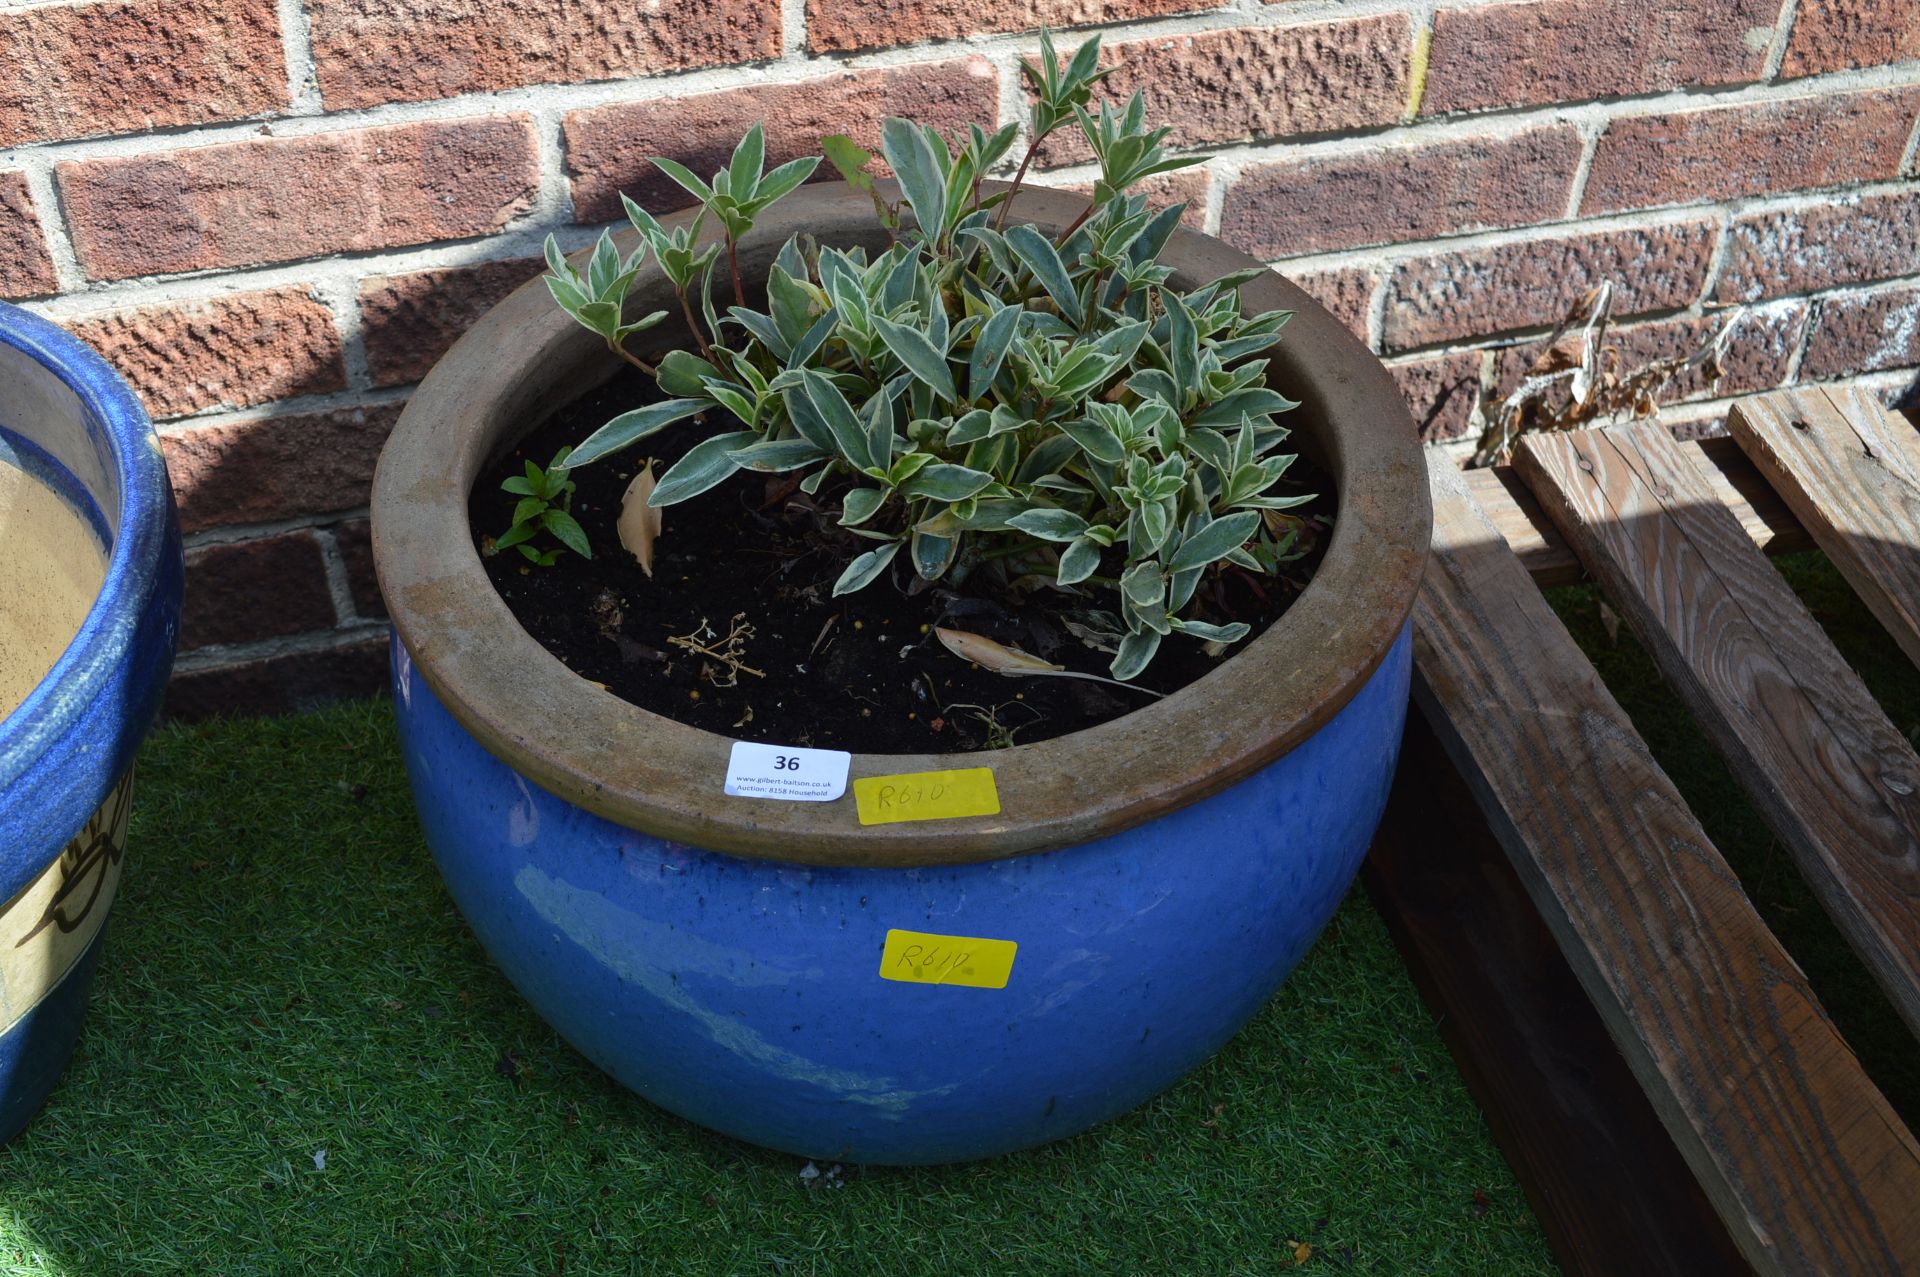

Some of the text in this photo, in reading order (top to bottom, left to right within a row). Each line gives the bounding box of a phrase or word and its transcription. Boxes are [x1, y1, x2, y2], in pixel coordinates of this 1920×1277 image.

[774, 755, 800, 771] 36
[736, 776, 832, 788] www.gilbert-baitson.co.uk
[736, 785, 828, 797] Auction: 8158 Household
